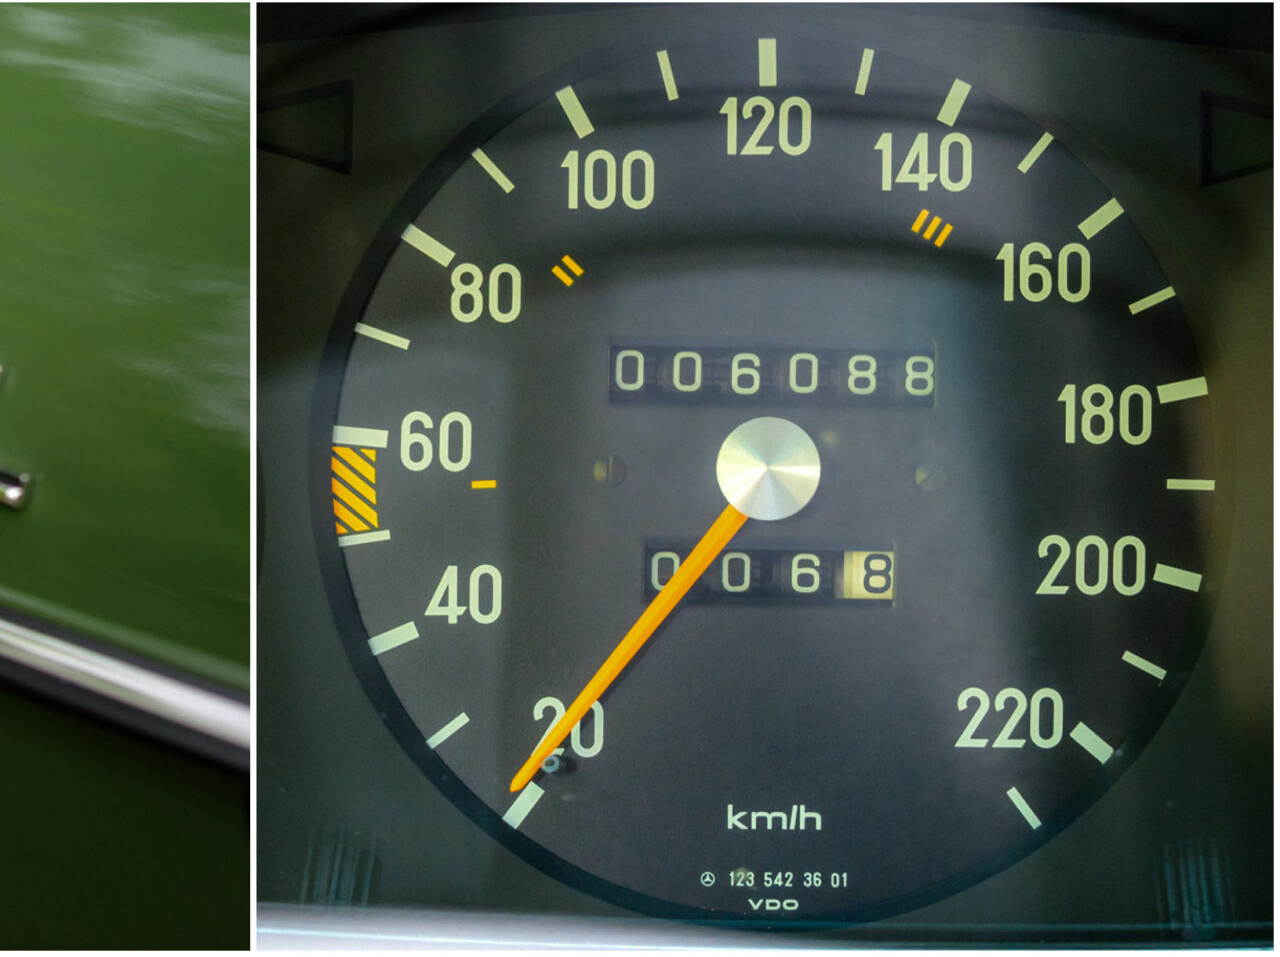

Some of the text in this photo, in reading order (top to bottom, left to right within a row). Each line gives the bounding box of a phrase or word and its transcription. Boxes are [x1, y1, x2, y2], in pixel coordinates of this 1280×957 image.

[720, 96, 812, 155] 120
[561, 150, 654, 209] 100
[874, 133, 972, 191] 140
[450, 263, 521, 323] 80
[996, 243, 1092, 302] 160
[616, 350, 934, 396] 006088
[400, 411, 472, 472] 60
[1058, 384, 1152, 445] 180
[425, 565, 502, 624] 40
[1036, 535, 1146, 596] 200
[531, 696, 604, 758] 20
[955, 687, 1064, 749] 220
[727, 803, 822, 831] km/h
[729, 871, 848, 888] 123 542 36 01
[748, 899, 799, 911] VDO
